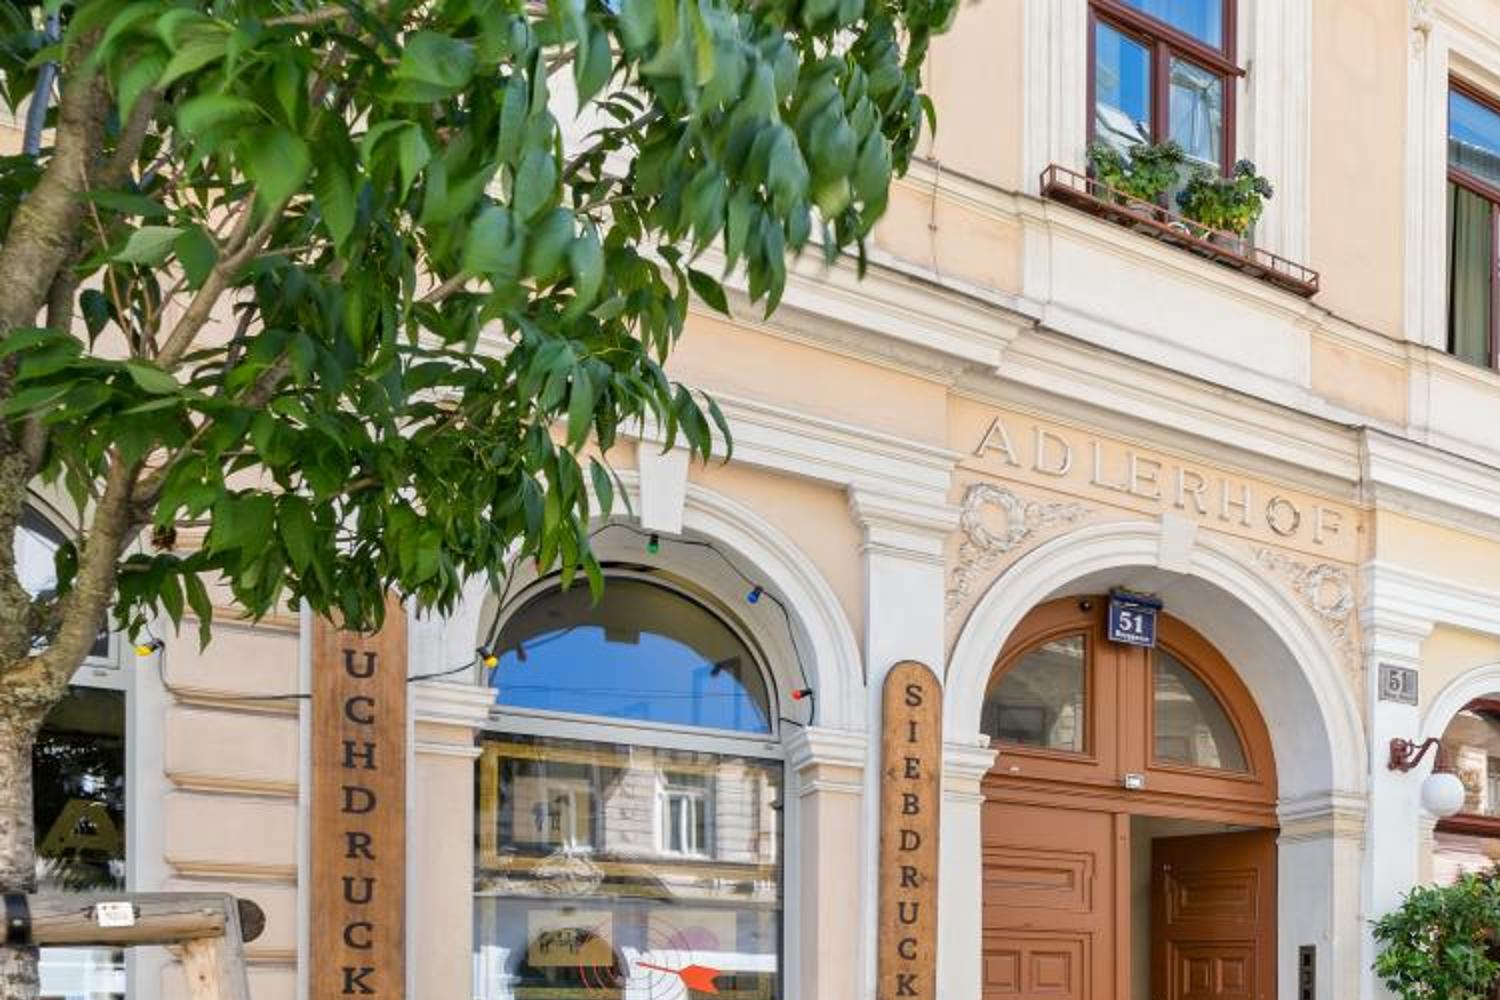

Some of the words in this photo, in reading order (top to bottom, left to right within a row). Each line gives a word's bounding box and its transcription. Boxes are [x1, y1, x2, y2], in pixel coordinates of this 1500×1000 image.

[974, 414, 1343, 546] ADLERHOF
[1119, 611, 1144, 634] 51
[1389, 669, 1408, 693] 51
[340, 648, 378, 996] UCHDRUCK
[895, 684, 924, 998] SIEBDRUCK
